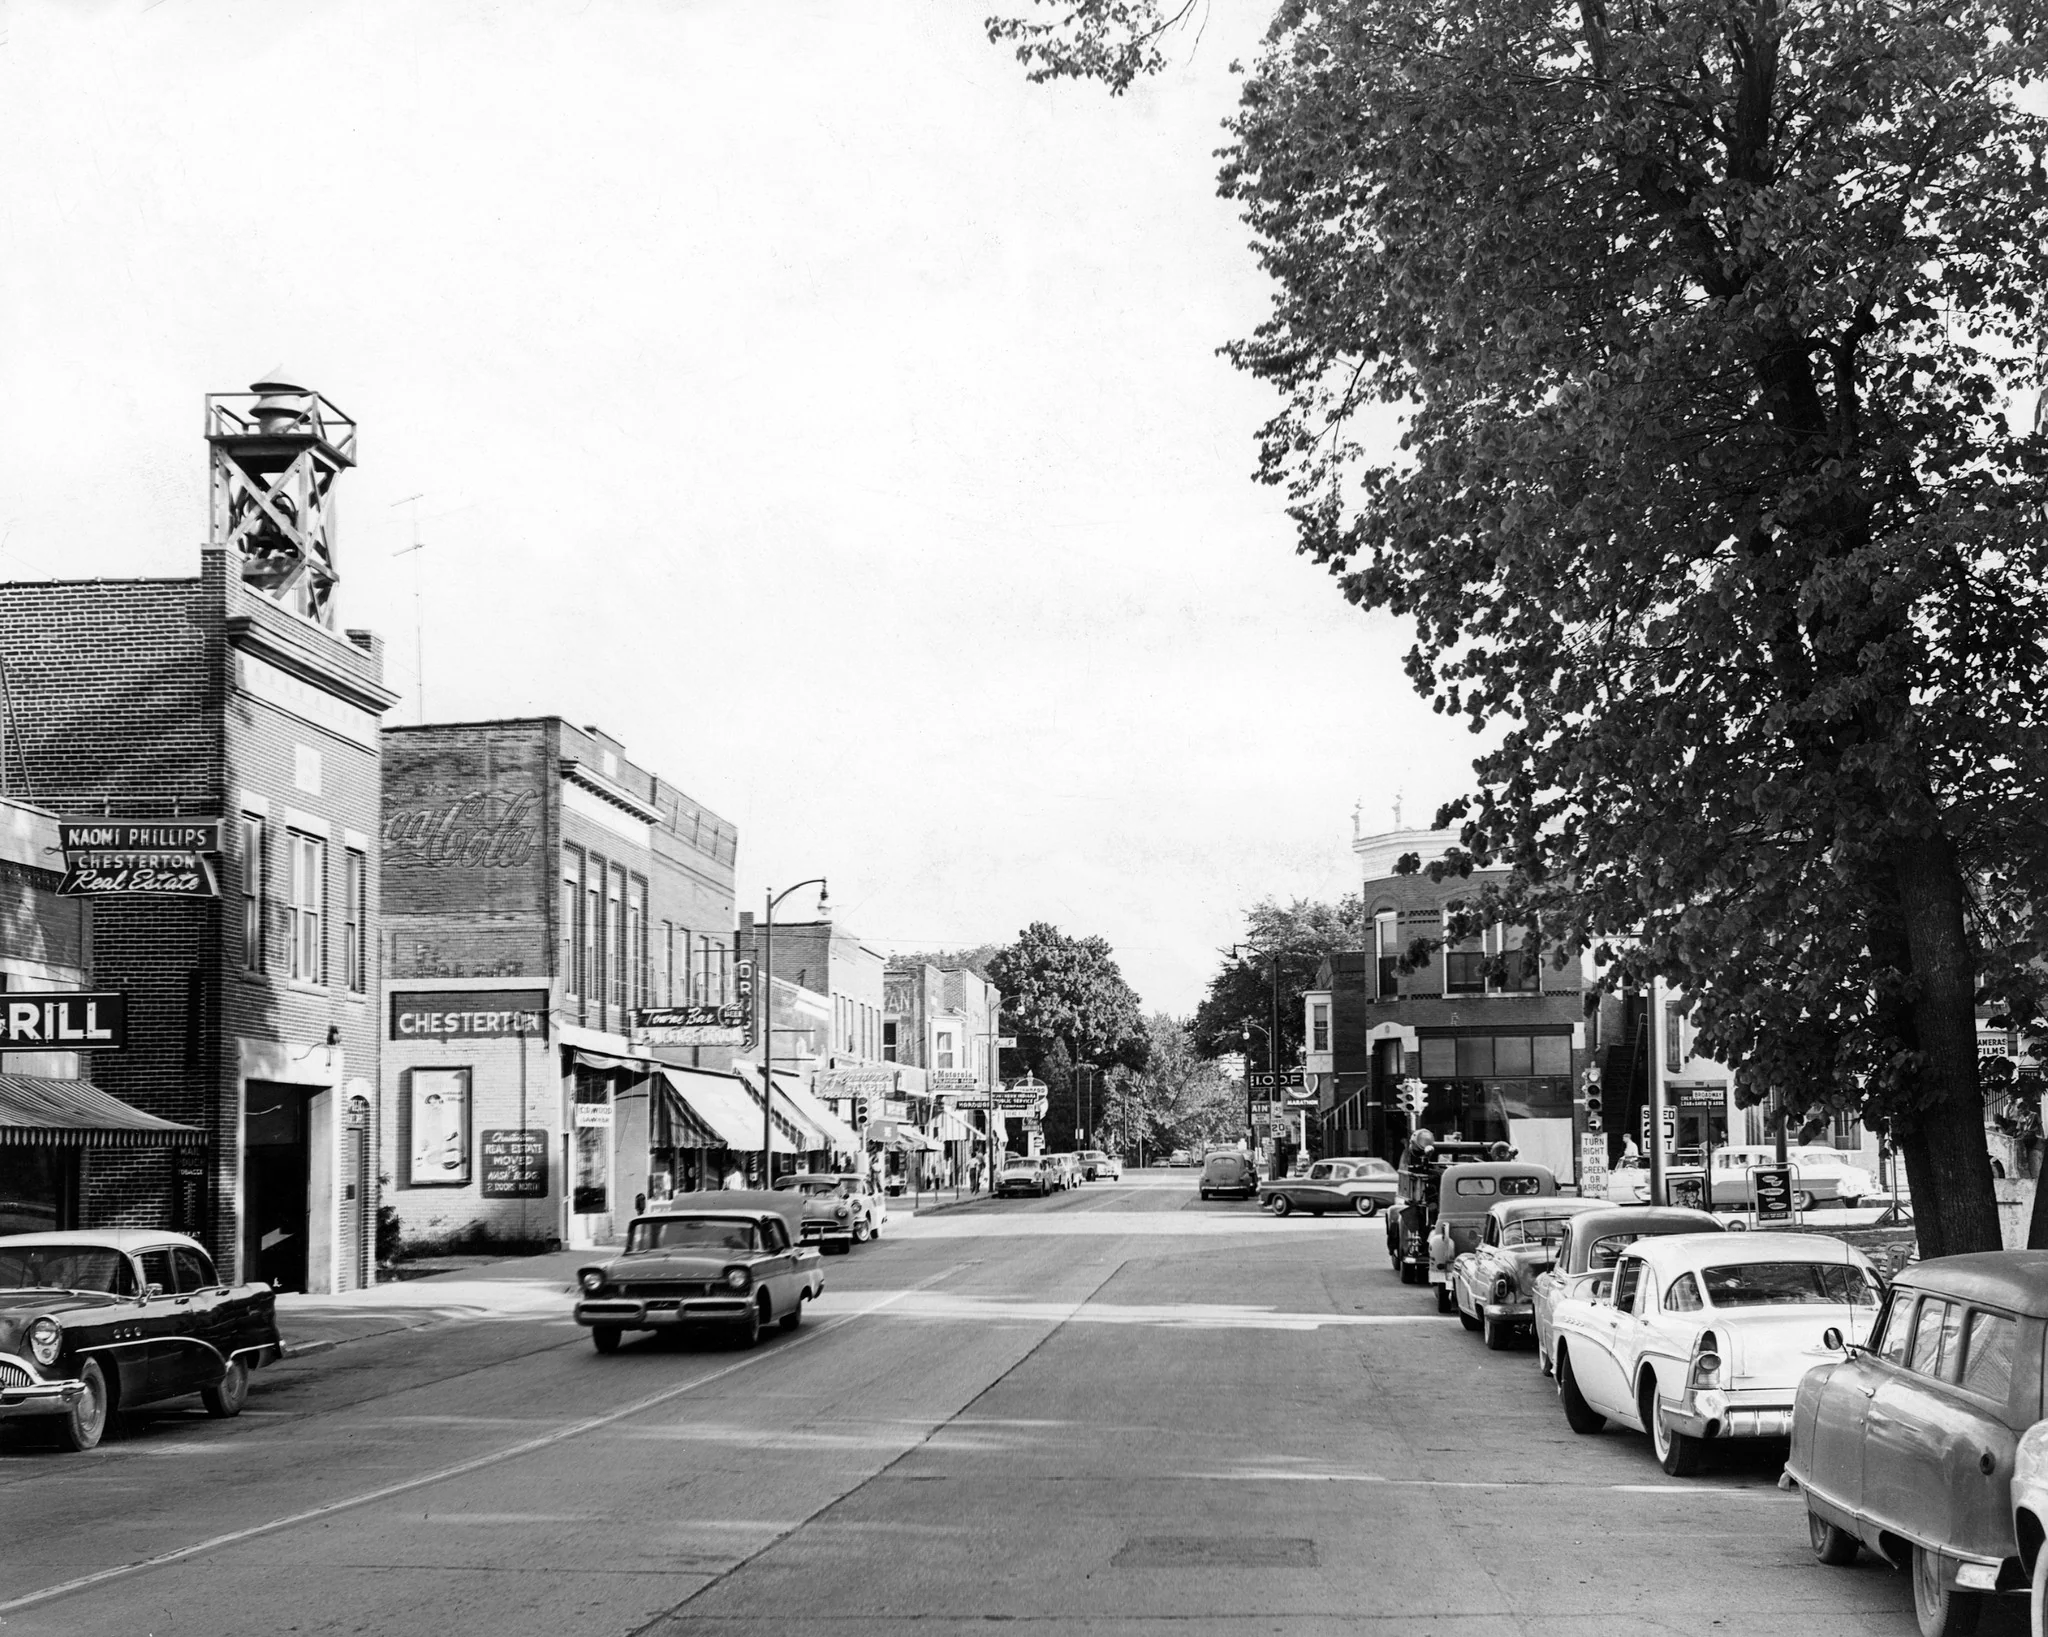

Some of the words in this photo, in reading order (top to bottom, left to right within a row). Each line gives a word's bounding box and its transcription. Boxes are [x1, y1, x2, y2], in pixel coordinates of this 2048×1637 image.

[68, 828, 121, 847] NAOMI
[129, 828, 207, 847] PHILLIPS
[78, 854, 196, 869] CHESTERTON
[68, 869, 128, 893] Real
[128, 869, 200, 891] Estate
[642, 1008, 685, 1026] Towne
[686, 1007, 717, 1025] Bar
[399, 1011, 541, 1034] CHESTERTON
[937, 1070, 973, 1078] Motorola
[1271, 1123, 1285, 1132] 20
[485, 1143, 506, 1154] REAL
[511, 1143, 544, 1154] ESTATE
[1583, 1147, 1605, 1155] RIGHT
[493, 1155, 534, 1166] MOVED
[1583, 1166, 1607, 1174] GREEN
[487, 1183, 493, 1191] 2
[494, 1182, 516, 1191] DOORS
[1583, 1184, 1608, 1192] ARROW
